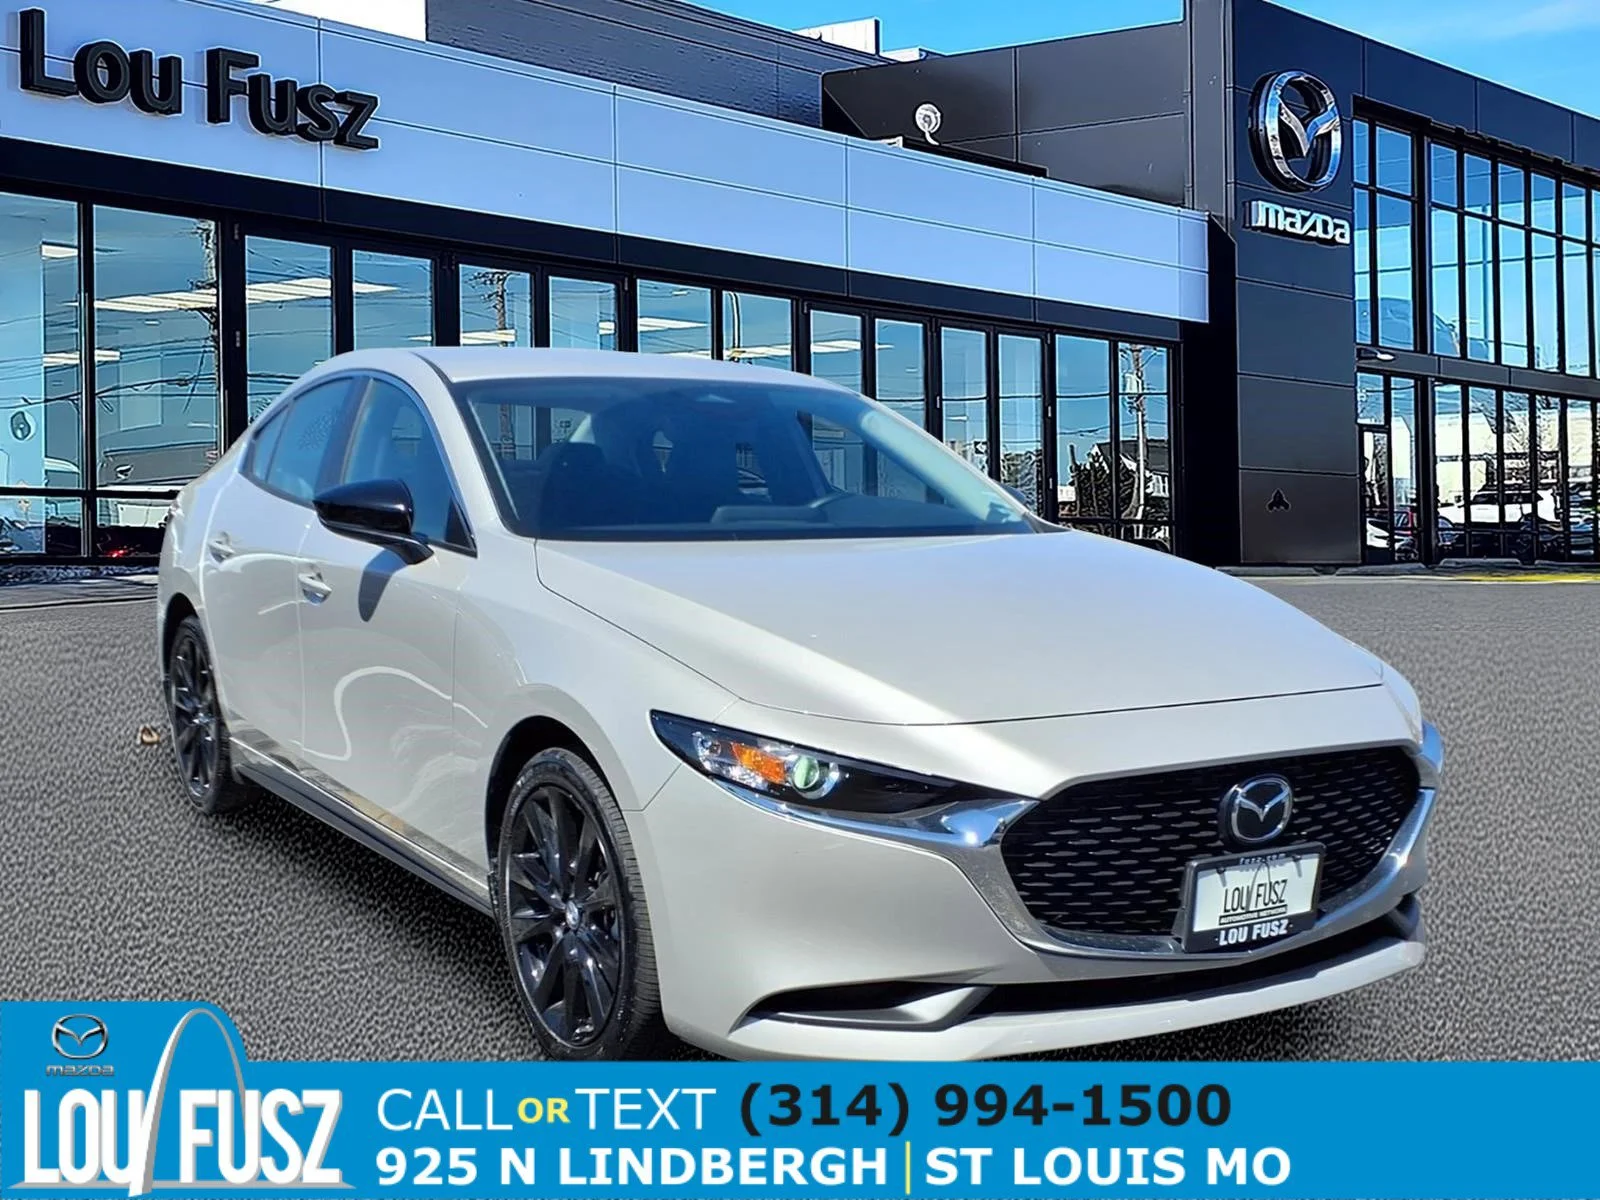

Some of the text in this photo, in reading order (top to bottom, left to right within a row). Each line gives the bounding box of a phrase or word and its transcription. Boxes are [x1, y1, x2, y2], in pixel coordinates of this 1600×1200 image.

[20, 8, 379, 150] Lou Fusz
[1223, 879, 1288, 913] LOU FUSZ
[1219, 919, 1289, 946] LOU FUSZ
